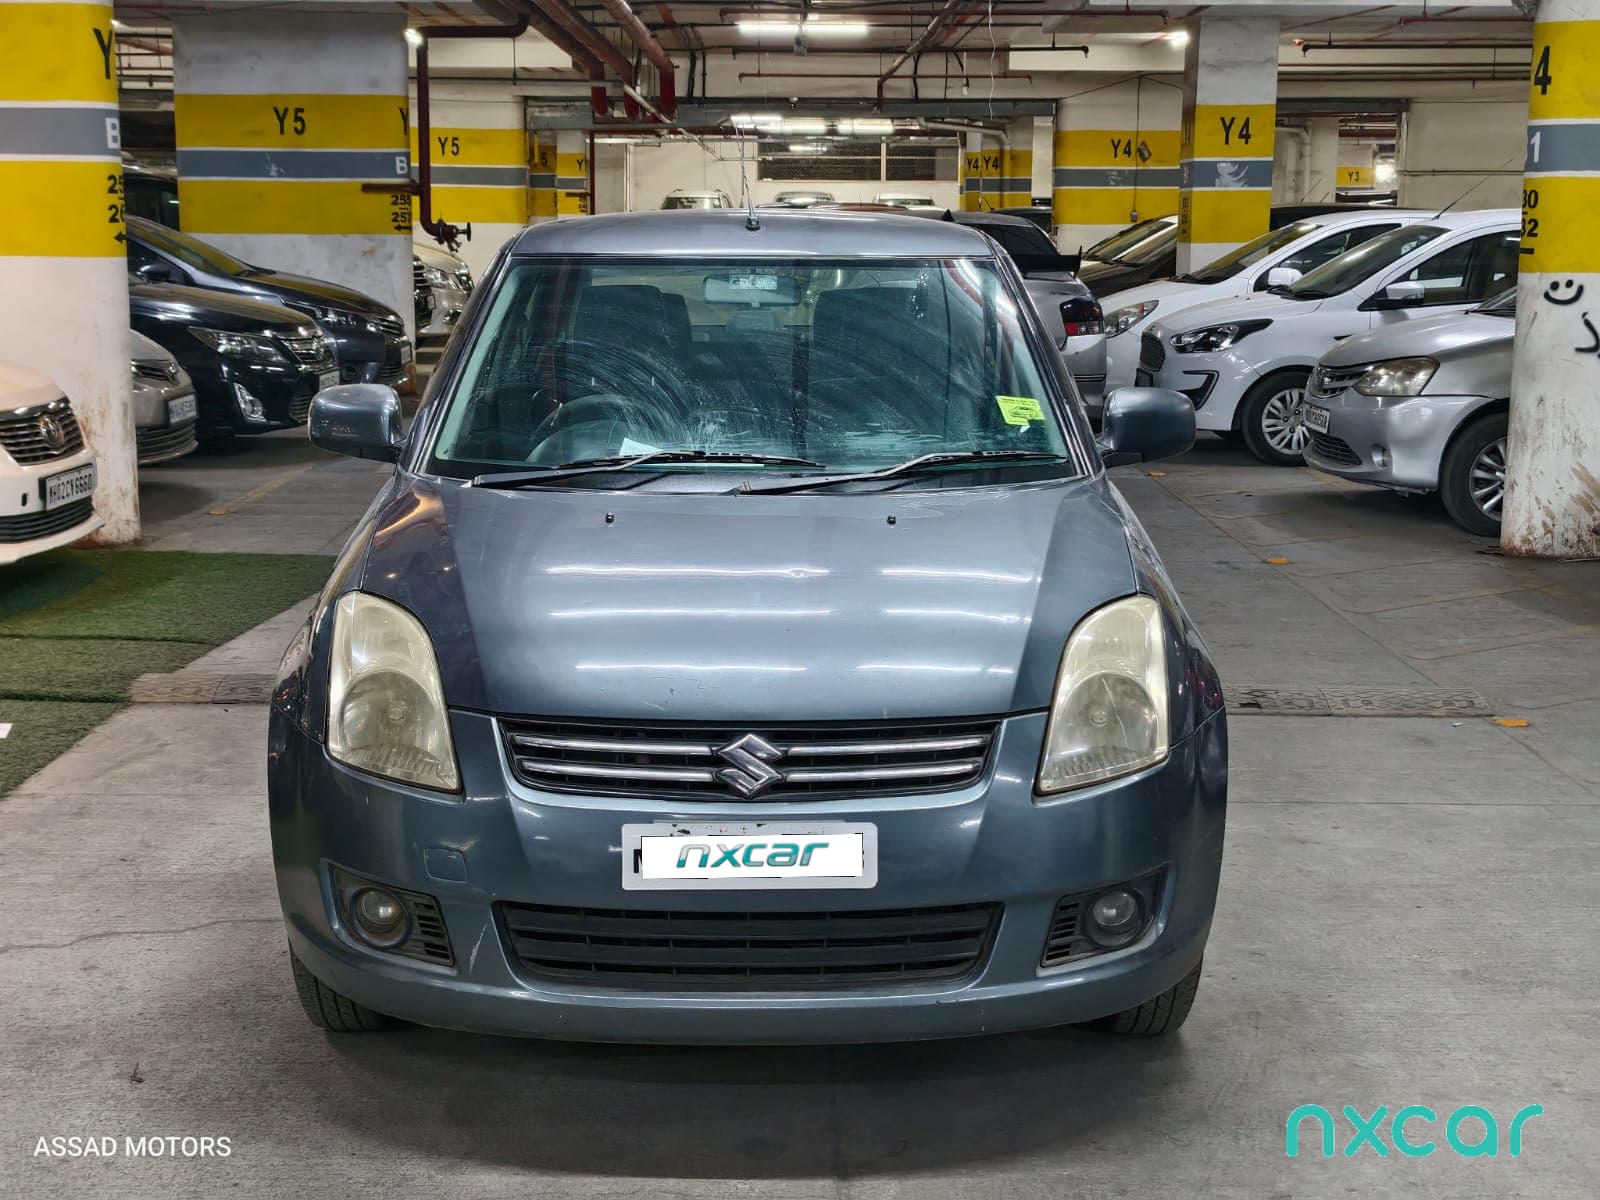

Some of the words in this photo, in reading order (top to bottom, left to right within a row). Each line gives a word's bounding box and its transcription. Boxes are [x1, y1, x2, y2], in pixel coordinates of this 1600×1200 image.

[272, 105, 306, 136] Y5
[1220, 116, 1252, 145] Y4
[105, 117, 121, 149] B
[437, 136, 460, 156] Y5
[1110, 138, 1132, 158] Y4
[396, 156, 408, 174] B
[966, 156, 979, 171] Y4
[983, 155, 999, 171] Y4
[1348, 171, 1360, 182] Y3
